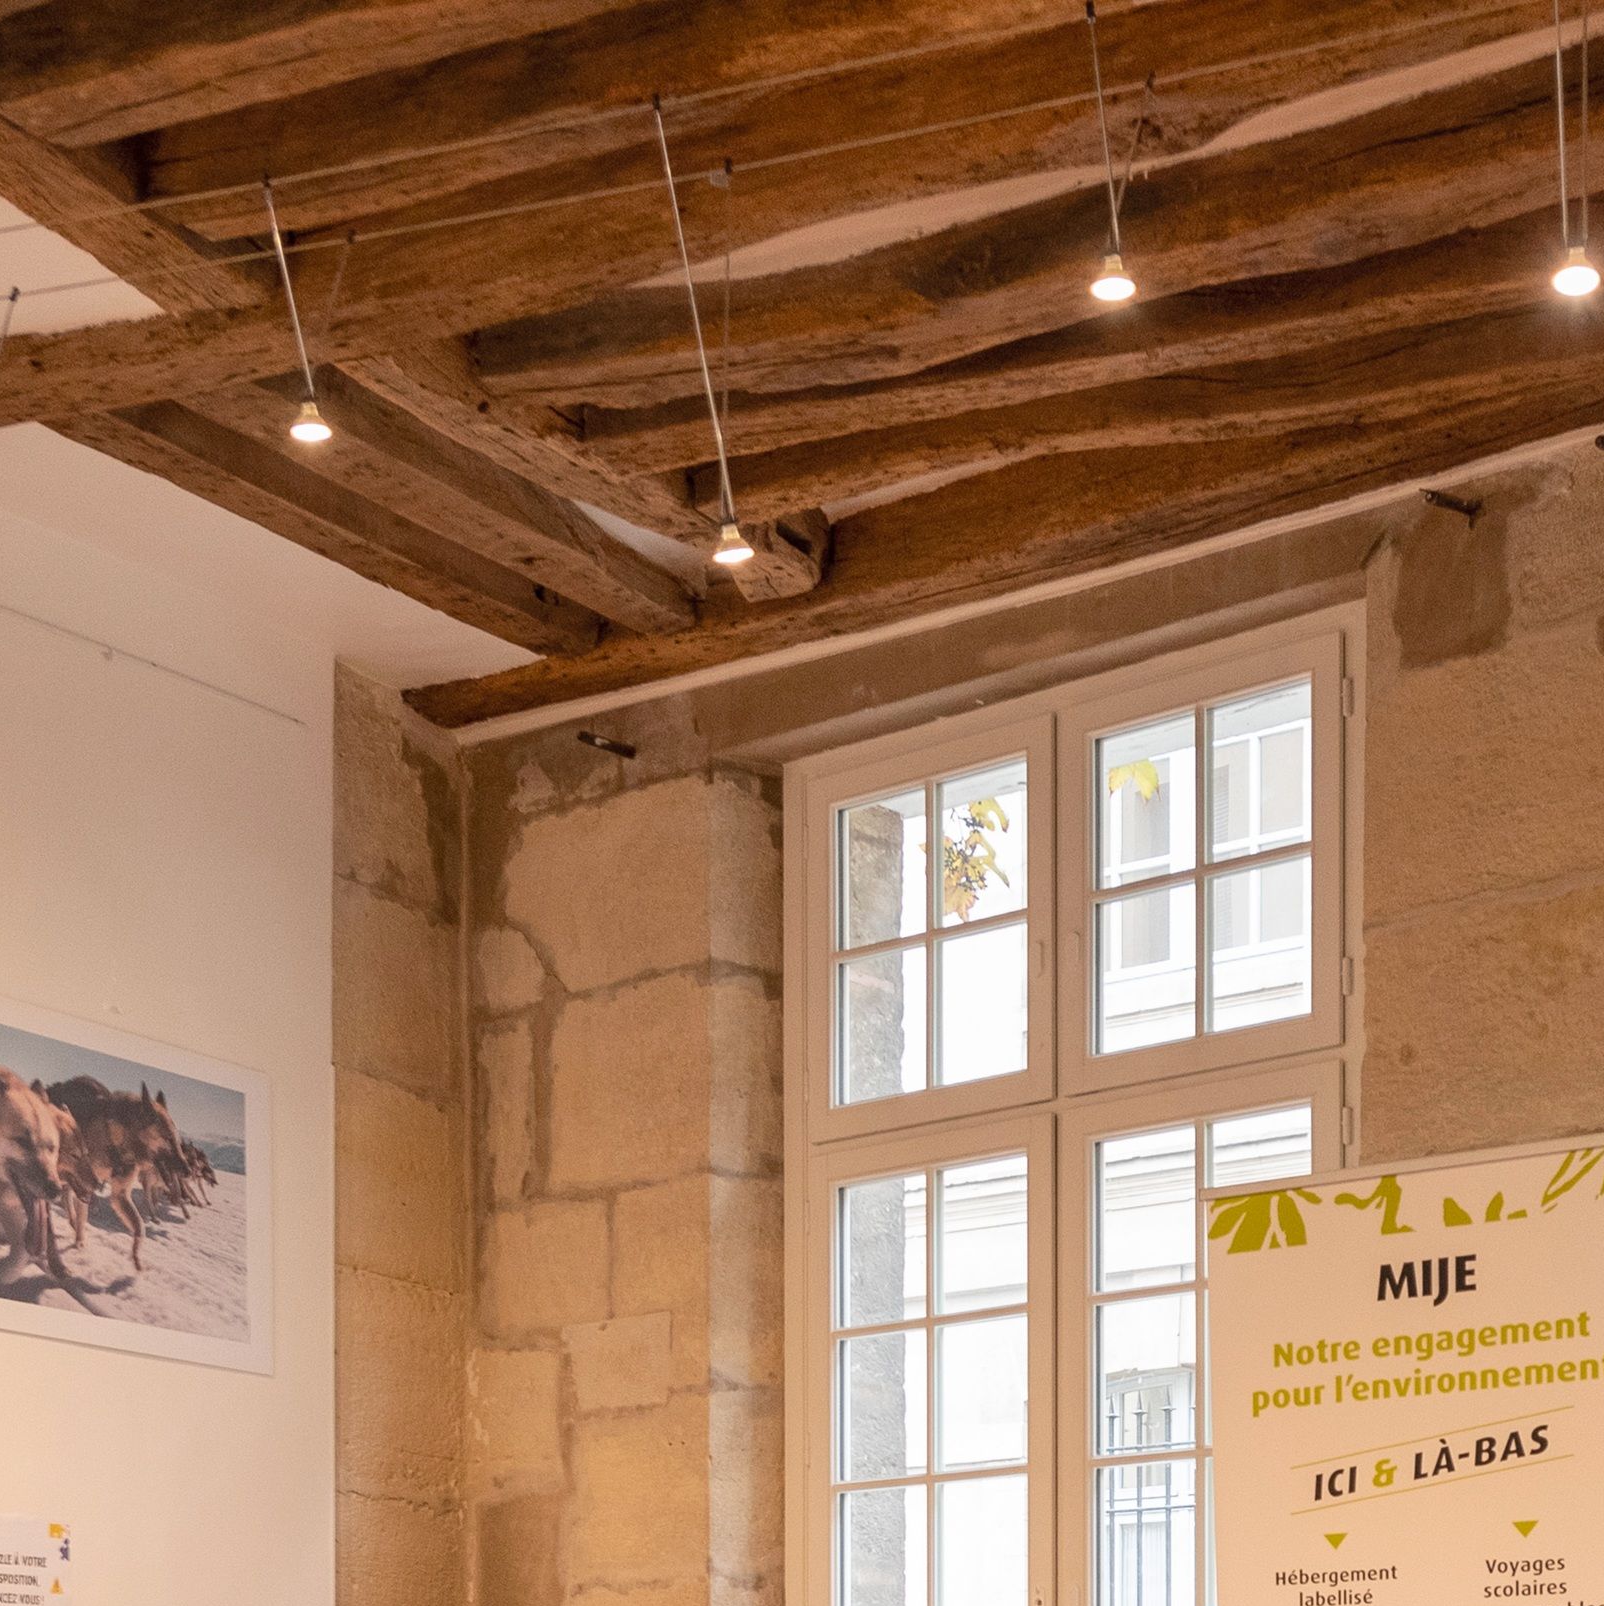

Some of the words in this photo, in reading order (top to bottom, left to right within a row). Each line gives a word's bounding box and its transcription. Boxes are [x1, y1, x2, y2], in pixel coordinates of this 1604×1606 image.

[1376, 1253, 1477, 1307] MIJE
[1272, 1338, 1361, 1368] Notre
[1371, 1311, 1591, 1361] engagement
[1251, 1383, 1326, 1418] pour
[1313, 1465, 1358, 1502] ICI
[1371, 1458, 1398, 1489] &
[1412, 1424, 1550, 1481] LÀ-BAS
[22, 1556, 47, 1568] VOTRE
[1485, 1558, 1566, 1577] Voyages
[1275, 1566, 1398, 1587] Hébergement
[1483, 1580, 1568, 1598] scolaires
